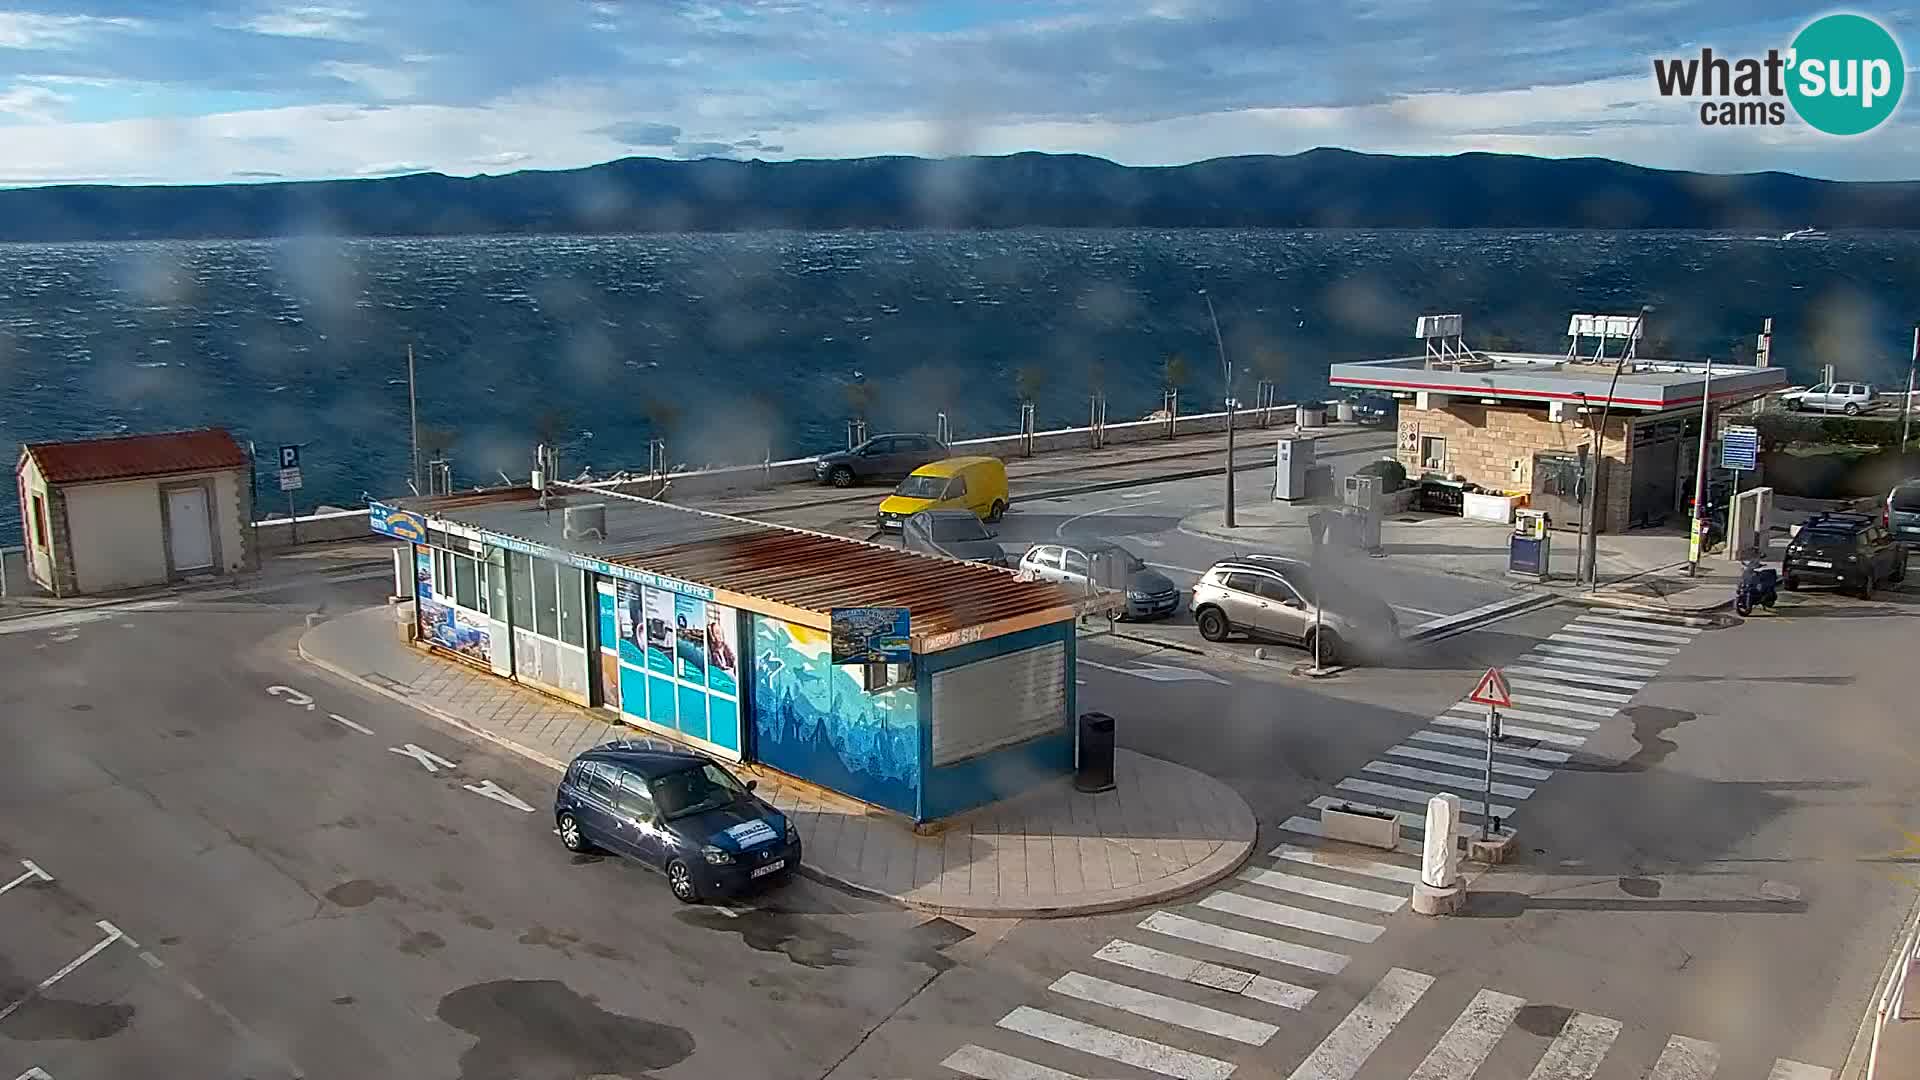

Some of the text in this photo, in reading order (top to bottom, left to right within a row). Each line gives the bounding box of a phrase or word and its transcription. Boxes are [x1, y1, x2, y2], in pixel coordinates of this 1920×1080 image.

[283, 448, 295, 466] P
[658, 577, 682, 592] TICKET
[683, 583, 711, 598] OFFICE
[960, 626, 985, 642] SKY
